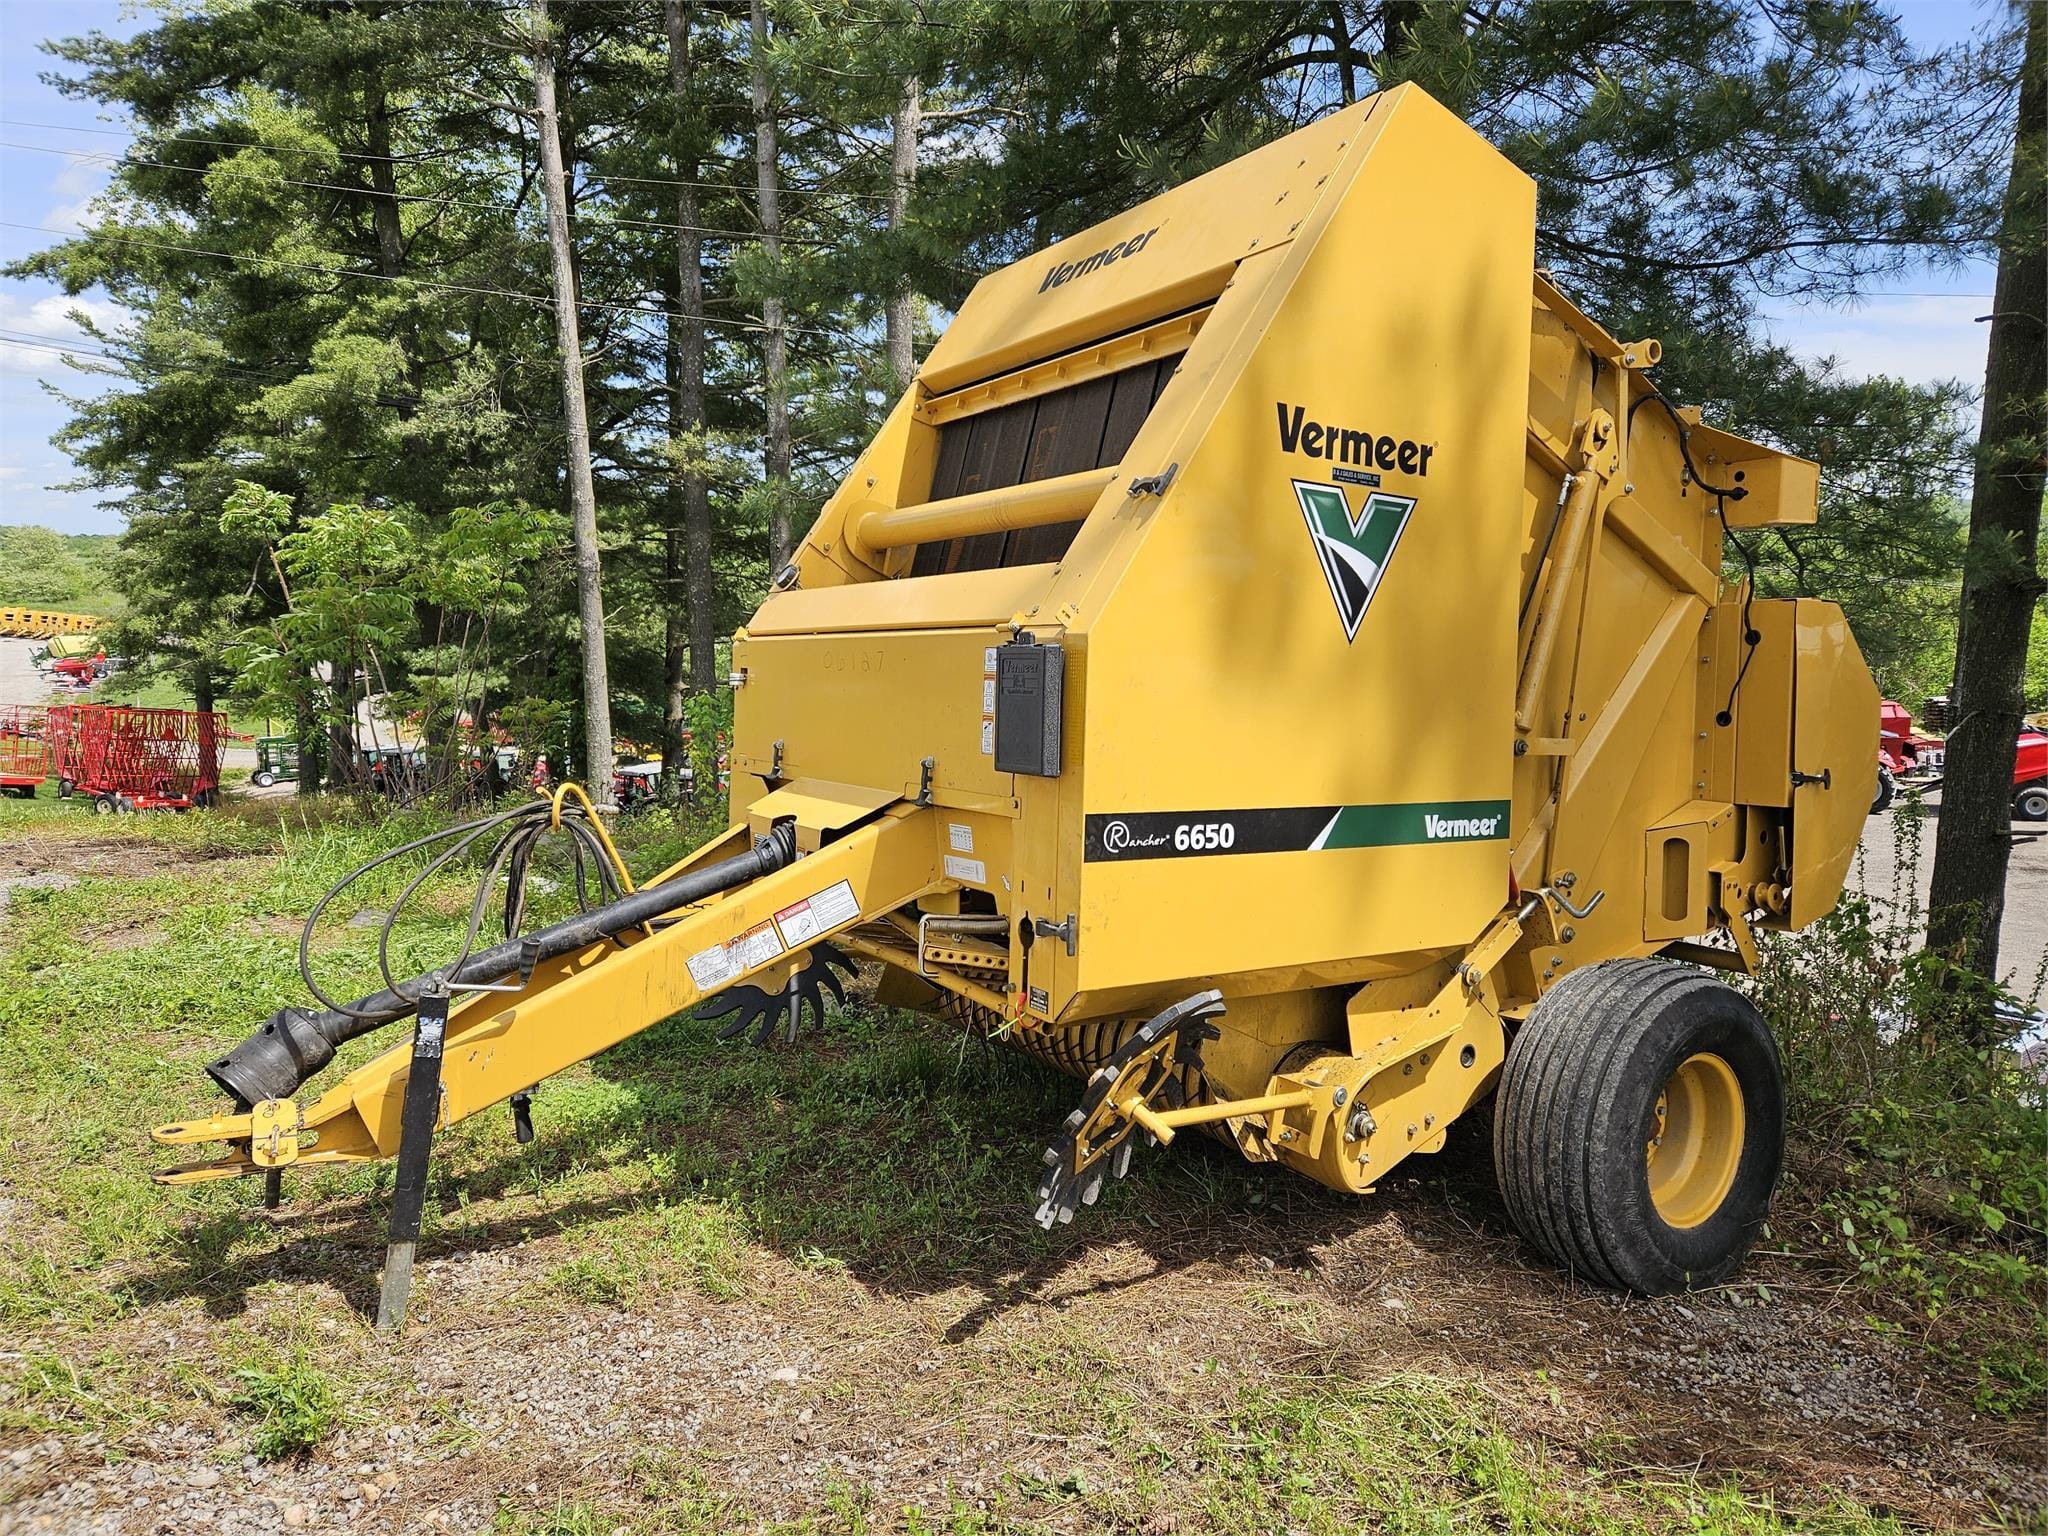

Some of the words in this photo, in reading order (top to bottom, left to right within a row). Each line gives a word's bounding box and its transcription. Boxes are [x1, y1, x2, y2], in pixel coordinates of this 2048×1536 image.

[1038, 226, 1160, 294] Vermeer
[1277, 402, 1434, 477] Vermeer
[1174, 822, 1235, 851] 6650
[1424, 814, 1498, 839] Vermeer
[738, 921, 770, 941] WARNING
